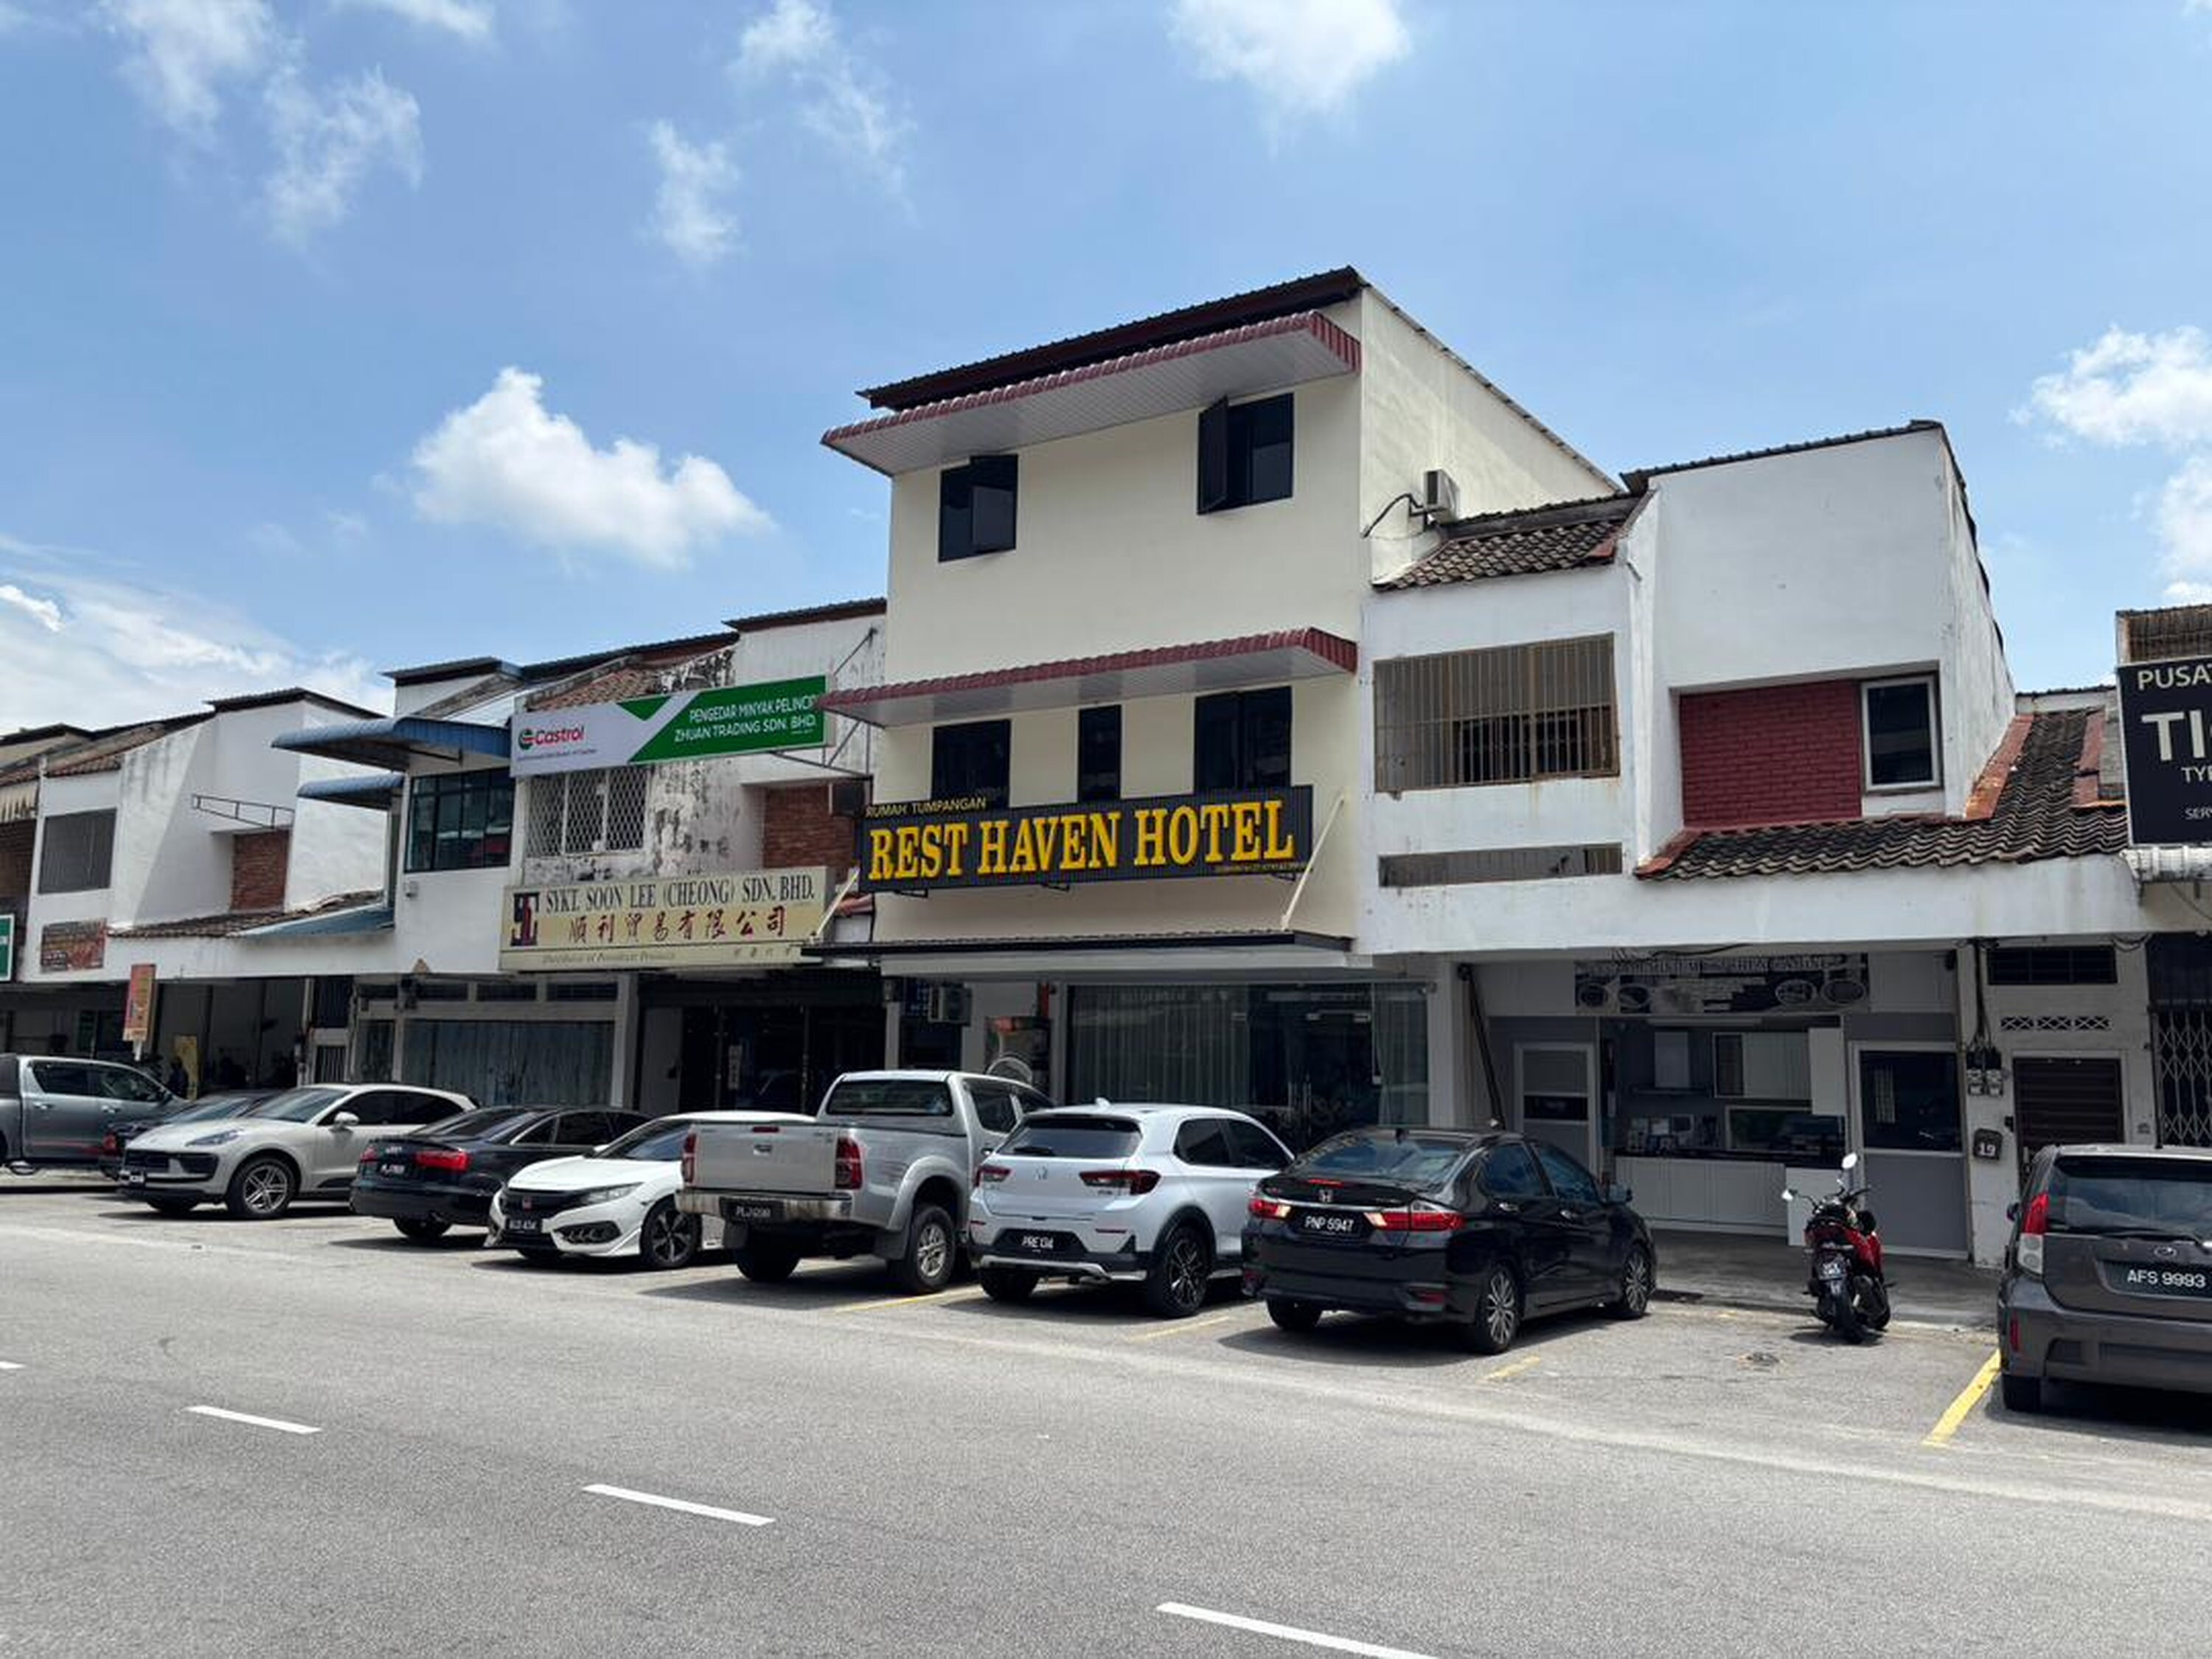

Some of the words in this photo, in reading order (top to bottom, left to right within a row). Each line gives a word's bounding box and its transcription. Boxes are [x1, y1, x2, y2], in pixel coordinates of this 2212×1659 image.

[535, 726, 585, 745] Castrol
[713, 720, 760, 738] TRADING
[2140, 709, 2212, 762] TI
[911, 796, 987, 815] TUMPANGAN
[868, 822, 969, 880] REST
[977, 812, 1121, 875] HAVEN
[1133, 799, 1295, 866] HOTEL
[586, 886, 623, 911] SOON
[630, 884, 656, 908] LEE
[664, 878, 736, 908] (CHEONG)
[742, 876, 776, 903] SDN.
[779, 874, 814, 902] BHD.
[1304, 1216, 1326, 1229] PNP
[2127, 1269, 2158, 1285] AFS
